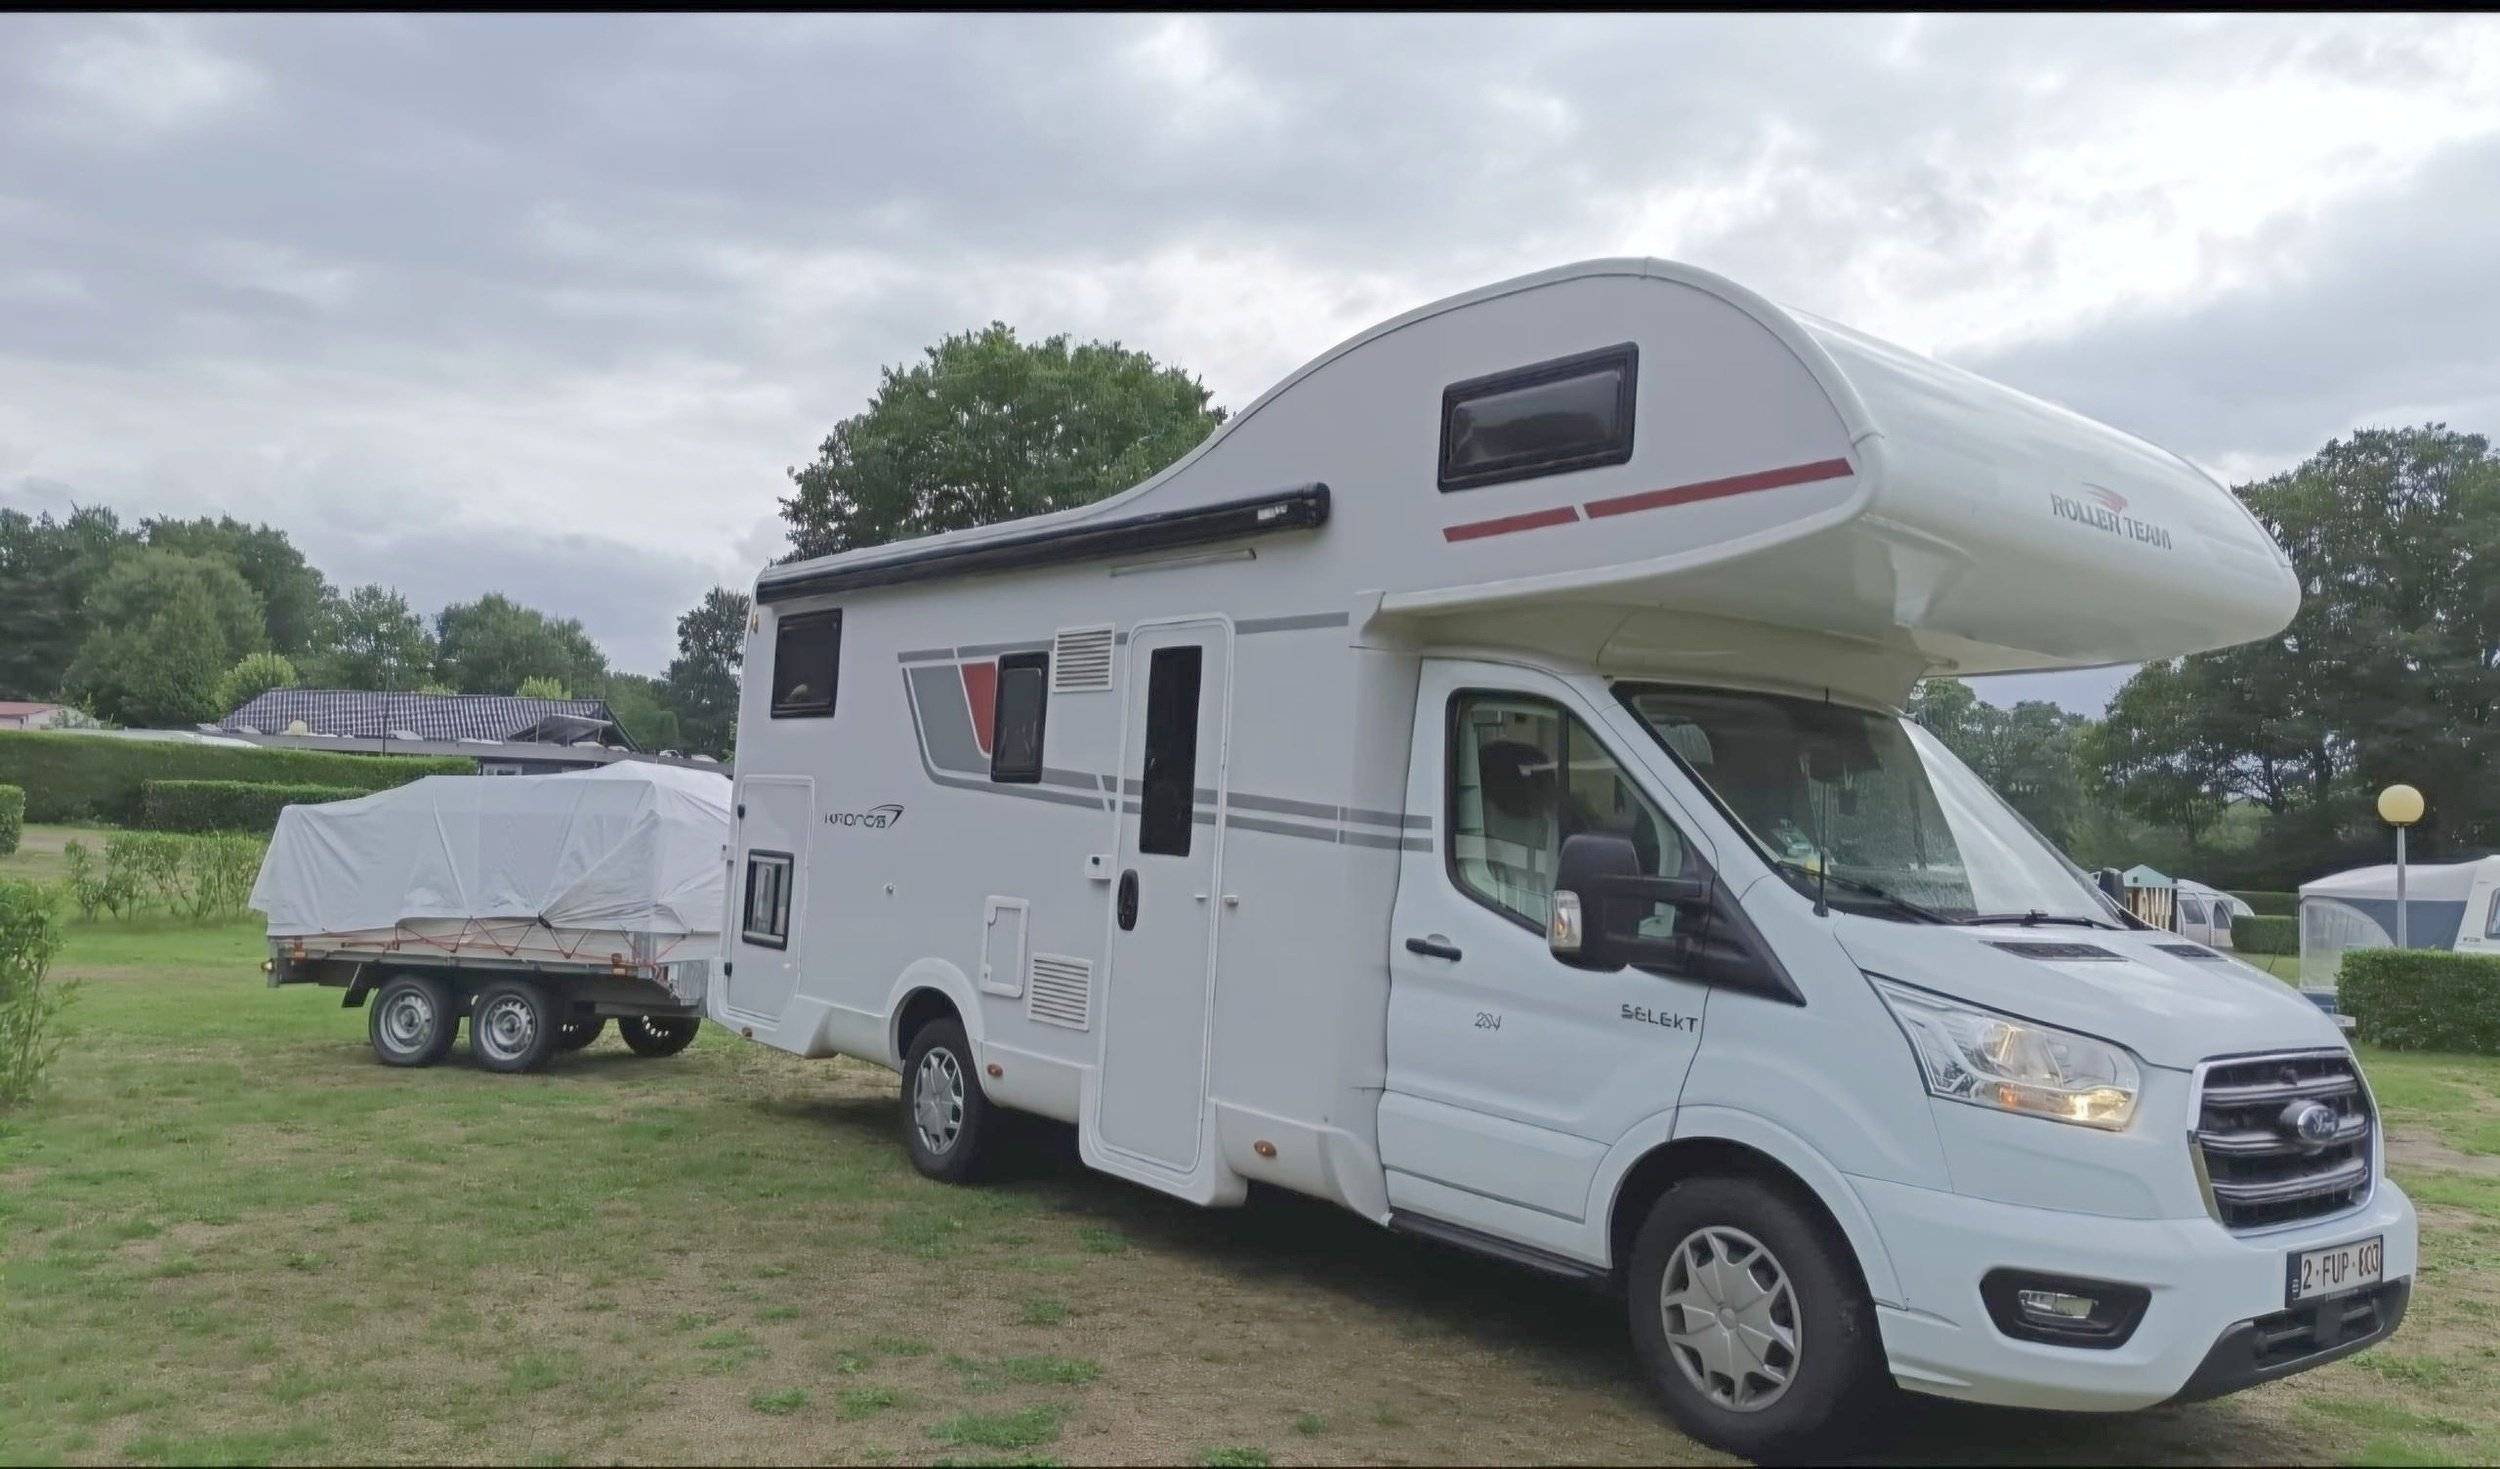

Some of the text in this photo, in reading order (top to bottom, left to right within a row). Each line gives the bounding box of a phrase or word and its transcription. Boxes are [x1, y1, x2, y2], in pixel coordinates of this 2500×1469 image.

[2050, 492, 2172, 551] ROLLER TEAM
[1621, 1003, 1699, 1033] SELEKT
